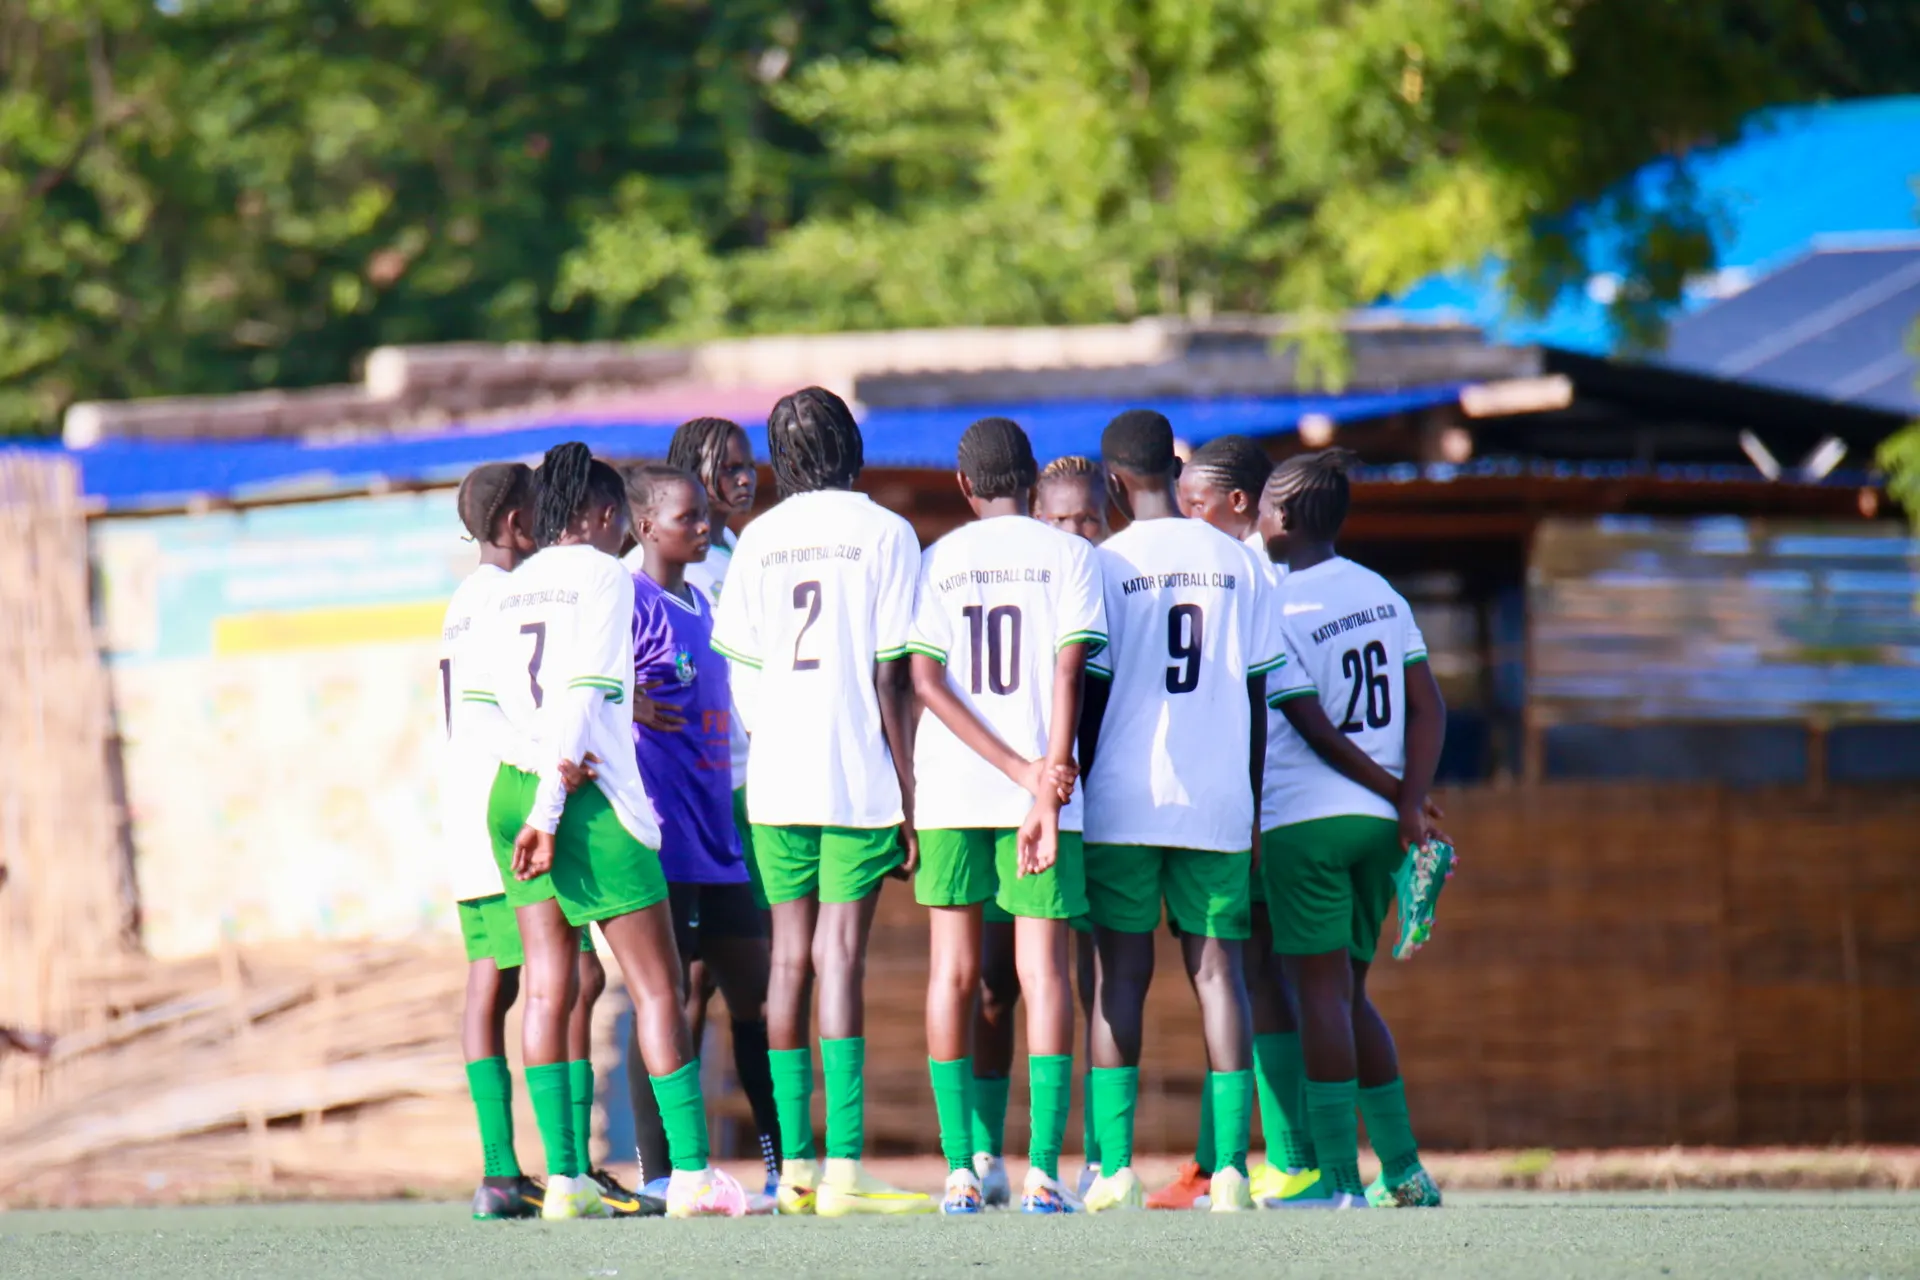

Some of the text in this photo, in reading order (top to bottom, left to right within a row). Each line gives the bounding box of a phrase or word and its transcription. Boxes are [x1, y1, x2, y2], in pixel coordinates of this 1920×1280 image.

[835, 544, 862, 561] CLUB
[939, 568, 1051, 593] KATOR FOOTBALL CLUB
[1122, 572, 1236, 596] KATOR FOOTBALL CLUB
[519, 621, 546, 710] 7
[792, 580, 822, 671] 2
[962, 604, 1022, 696] 10
[1165, 603, 1204, 694] 9
[1311, 620, 1341, 646] KATOR
[1338, 608, 1376, 633] FOOTBALL
[1337, 640, 1391, 734] 26
